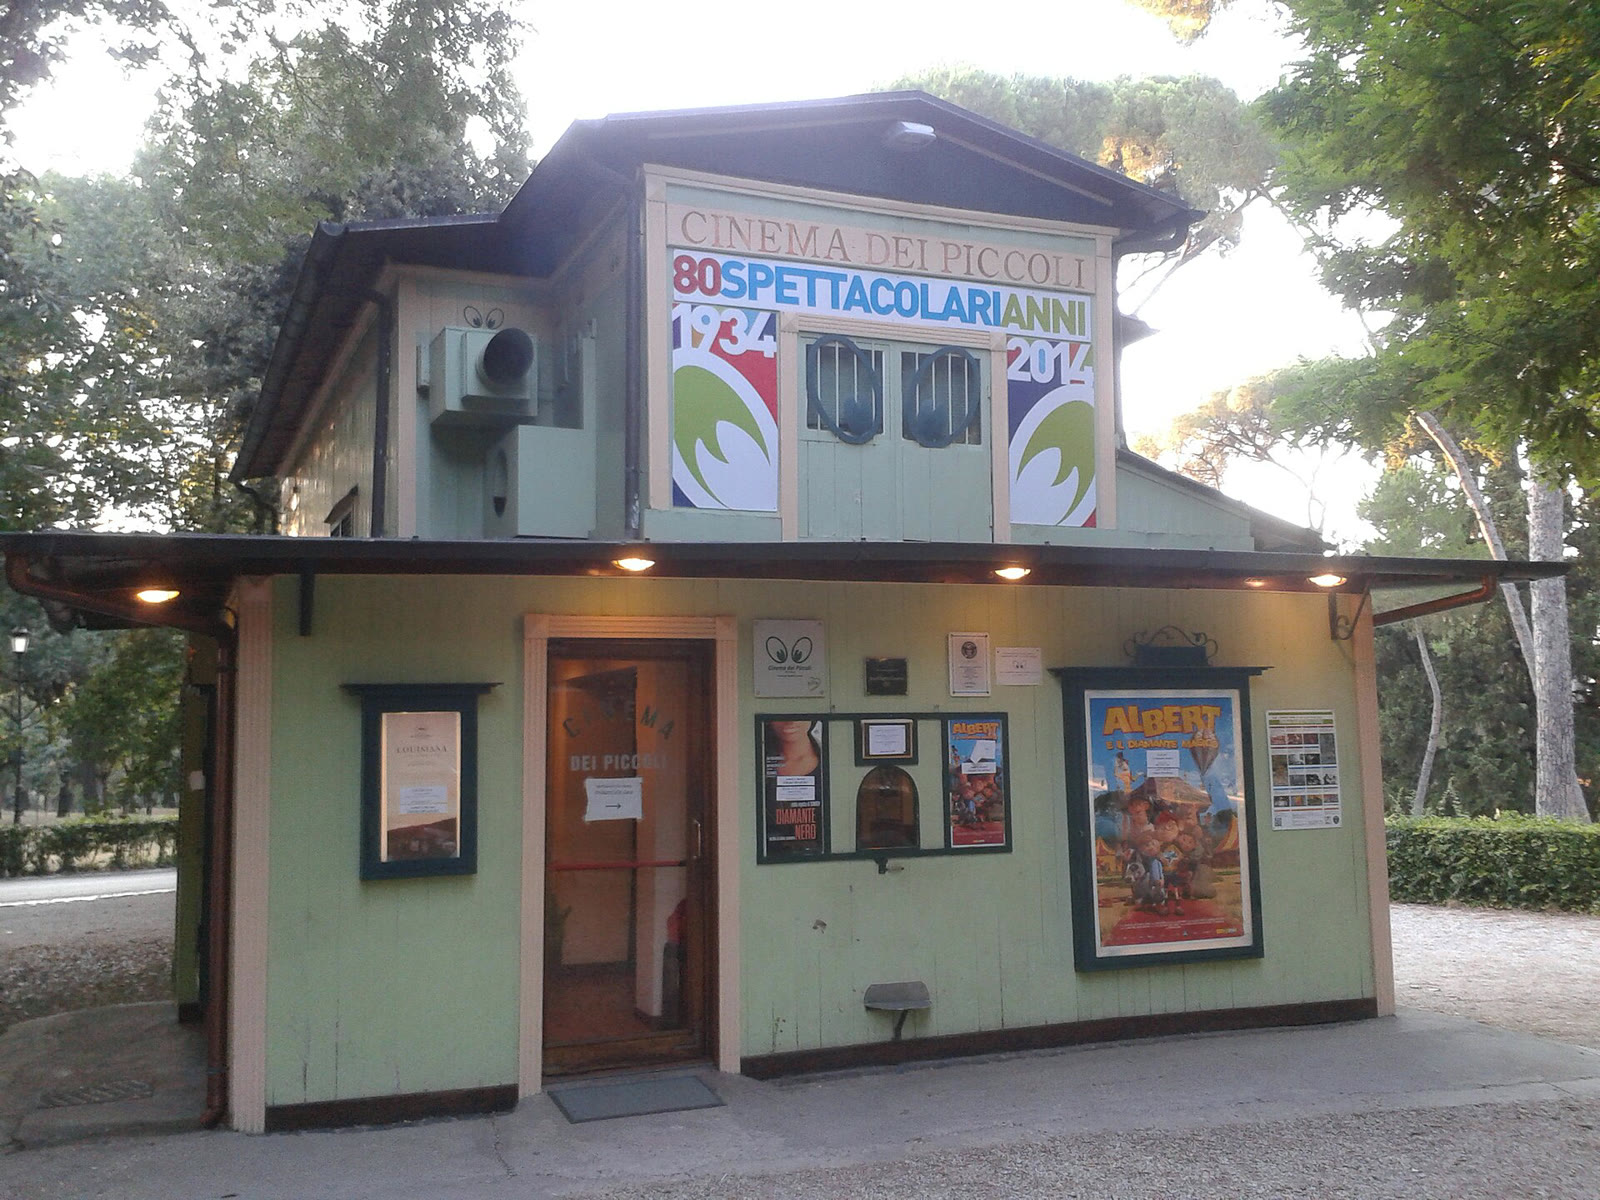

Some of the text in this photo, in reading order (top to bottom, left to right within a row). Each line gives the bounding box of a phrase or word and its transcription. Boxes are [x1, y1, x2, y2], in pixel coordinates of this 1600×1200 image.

[681, 211, 1085, 288] CINEMA DEI PICCOLI
[672, 304, 777, 358] 1934
[1006, 337, 1094, 385] 2014
[952, 722, 999, 736] ALBERT
[1103, 705, 1222, 738] ALBERT
[397, 745, 447, 753] LOUISIANA
[1106, 741, 1114, 750] E
[1127, 739, 1179, 749] DIAMANTE
[570, 755, 597, 771] DEI
[776, 808, 816, 824] DIAMANTE
[795, 824, 816, 840] NERO
